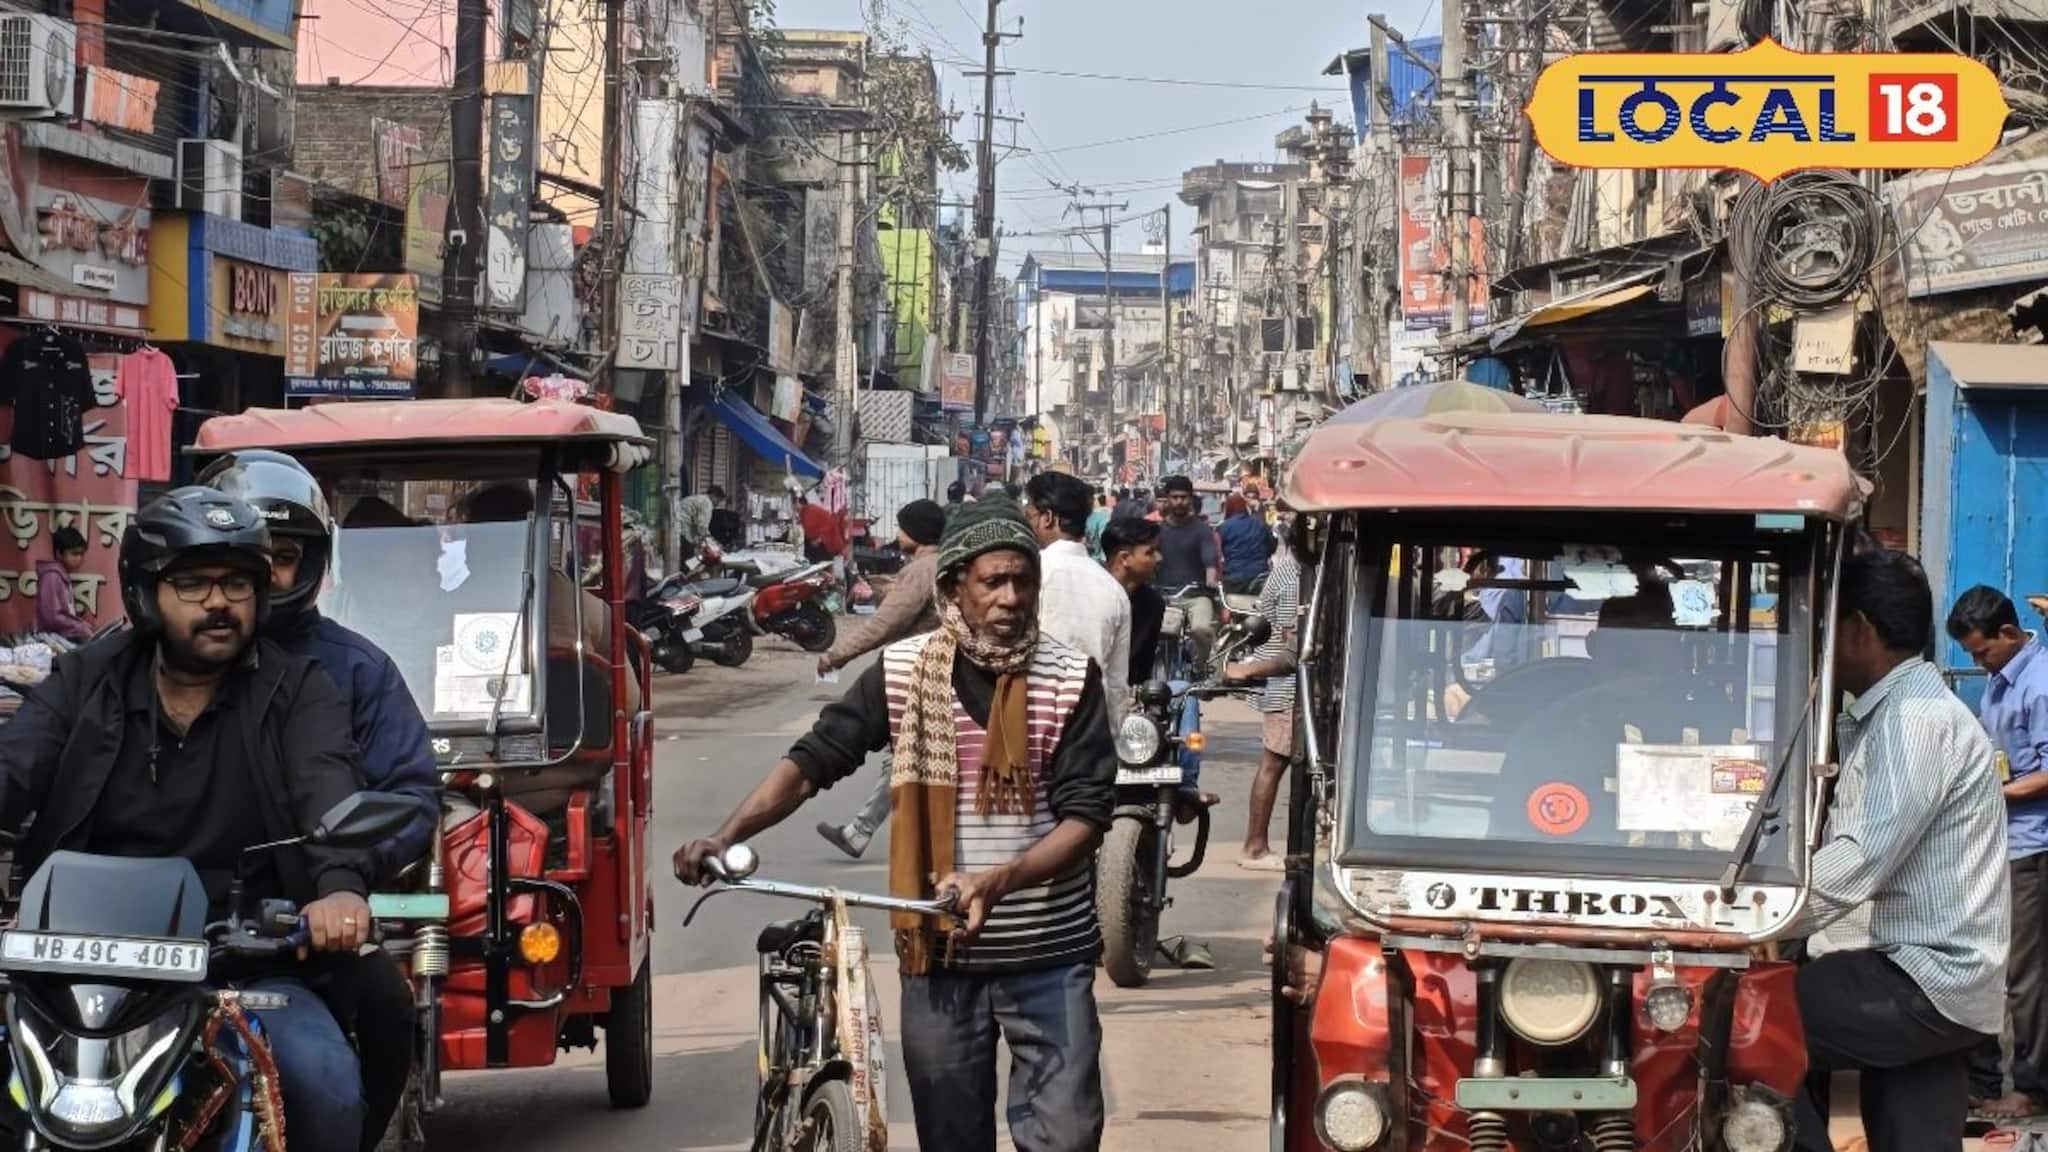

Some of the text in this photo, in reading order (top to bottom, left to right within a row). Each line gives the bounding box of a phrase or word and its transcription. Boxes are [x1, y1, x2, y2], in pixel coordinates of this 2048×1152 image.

[319, 328, 366, 365] ব্লাউজ
[34, 936, 197, 969] WB 49C 4061
